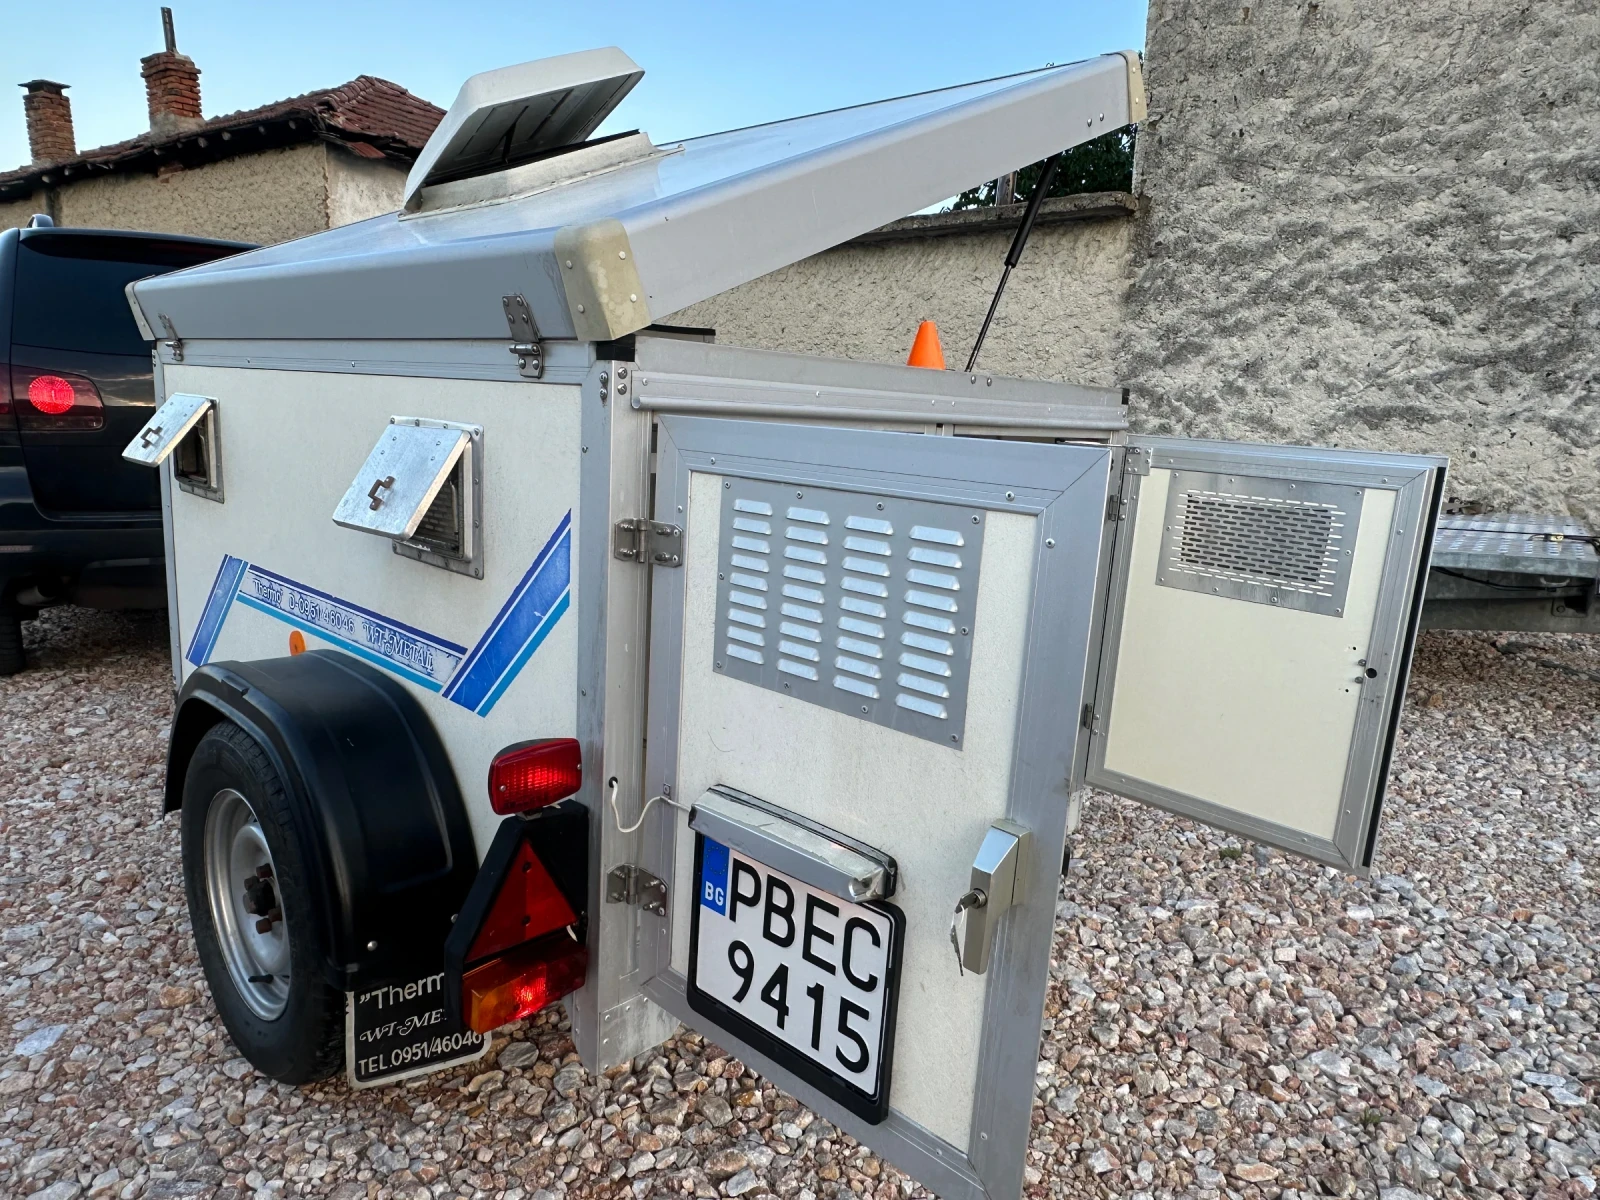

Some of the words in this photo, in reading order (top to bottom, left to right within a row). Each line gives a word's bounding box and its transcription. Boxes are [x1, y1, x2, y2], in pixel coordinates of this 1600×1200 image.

[704, 881, 725, 907] BG
[729, 858, 881, 993] PBEC
[728, 940, 870, 1073] 9415
